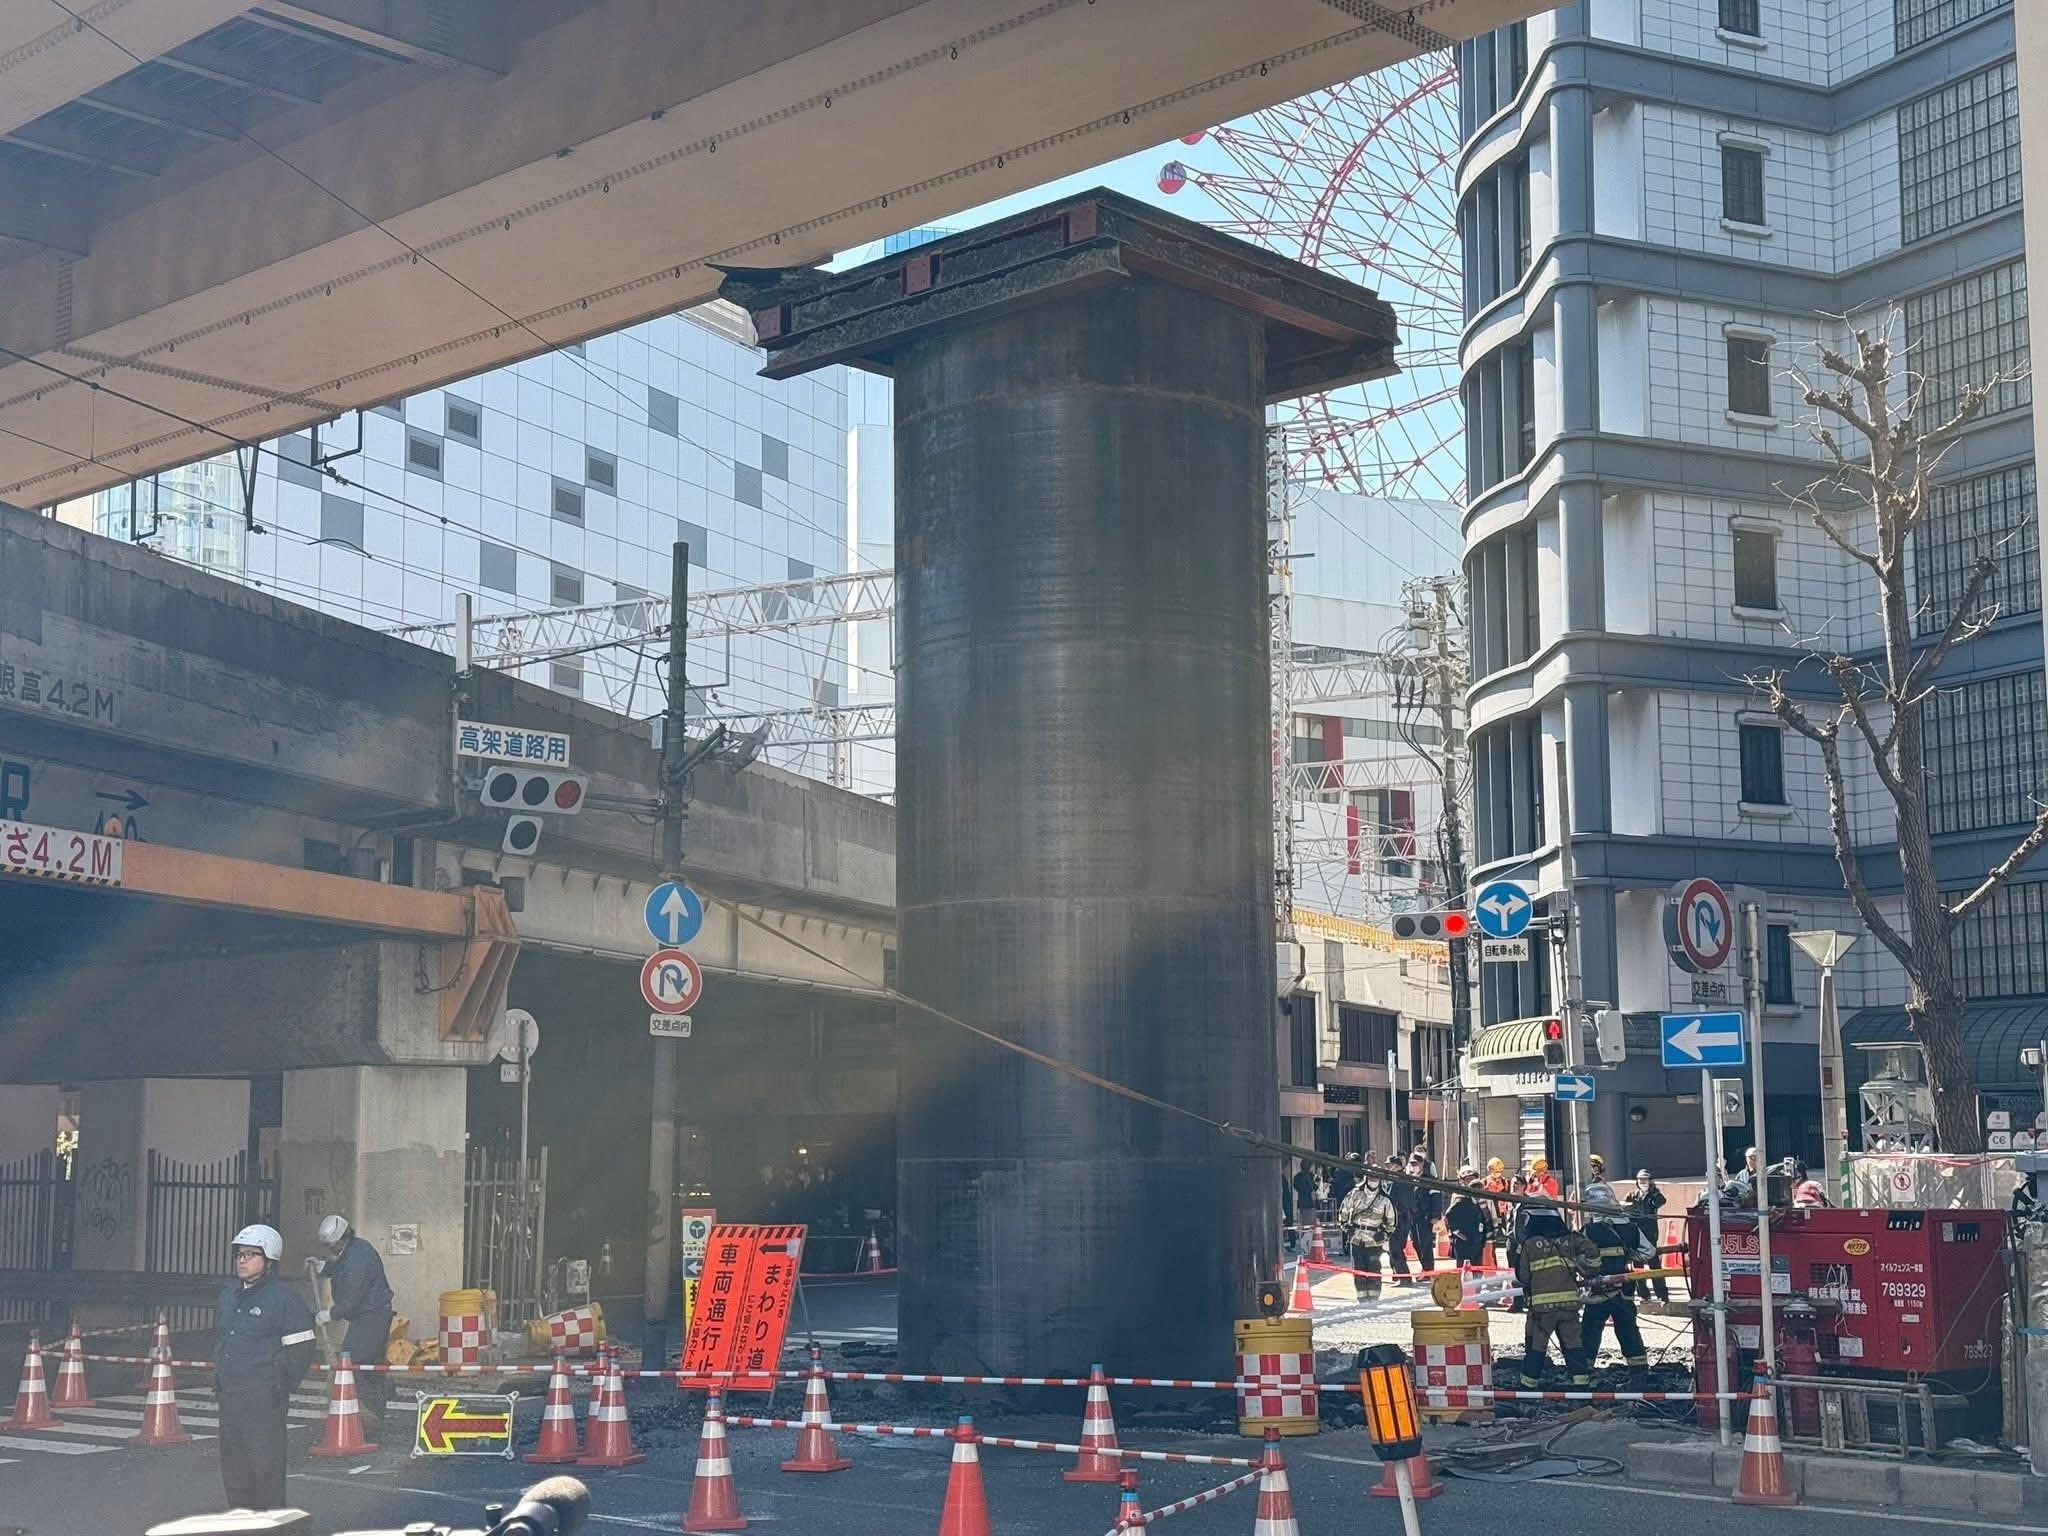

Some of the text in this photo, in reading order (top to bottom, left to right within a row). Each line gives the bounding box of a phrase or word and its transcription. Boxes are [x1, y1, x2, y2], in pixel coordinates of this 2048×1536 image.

[459, 725, 566, 762] 高架道路用
[6, 826, 113, 878] さ4.2M
[1484, 943, 1527, 957] 自転車を除く
[1692, 980, 1726, 999] 交差点内
[651, 1018, 690, 1033] 交差点内
[1880, 1282, 1927, 1298] 789329
[744, 1263, 782, 1370] まわり道
